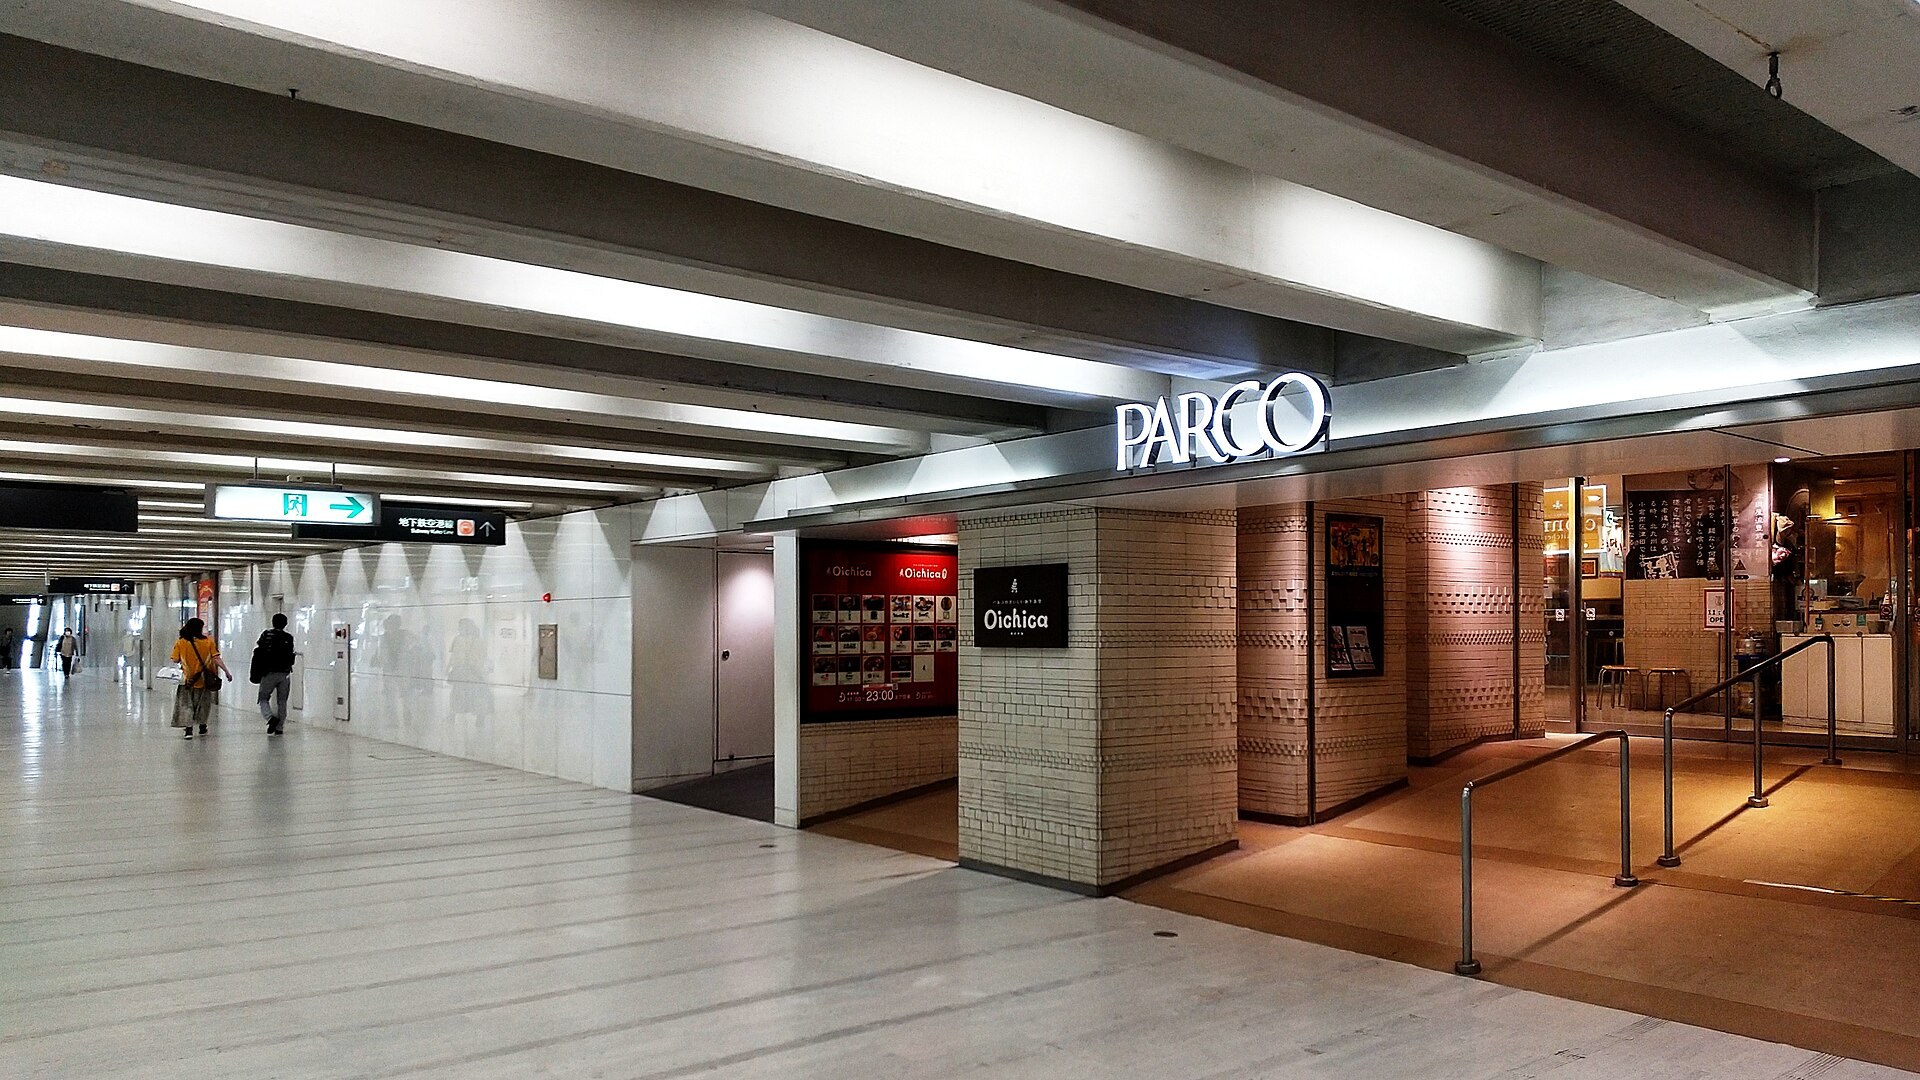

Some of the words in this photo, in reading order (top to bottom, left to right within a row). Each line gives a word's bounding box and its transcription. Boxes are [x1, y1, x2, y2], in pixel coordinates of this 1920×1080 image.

[1115, 371, 1332, 471] PARCO
[832, 566, 872, 577] Oichica
[904, 568, 941, 579] Oichica
[984, 608, 1049, 630] Oichica
[866, 690, 894, 702] 23:00
